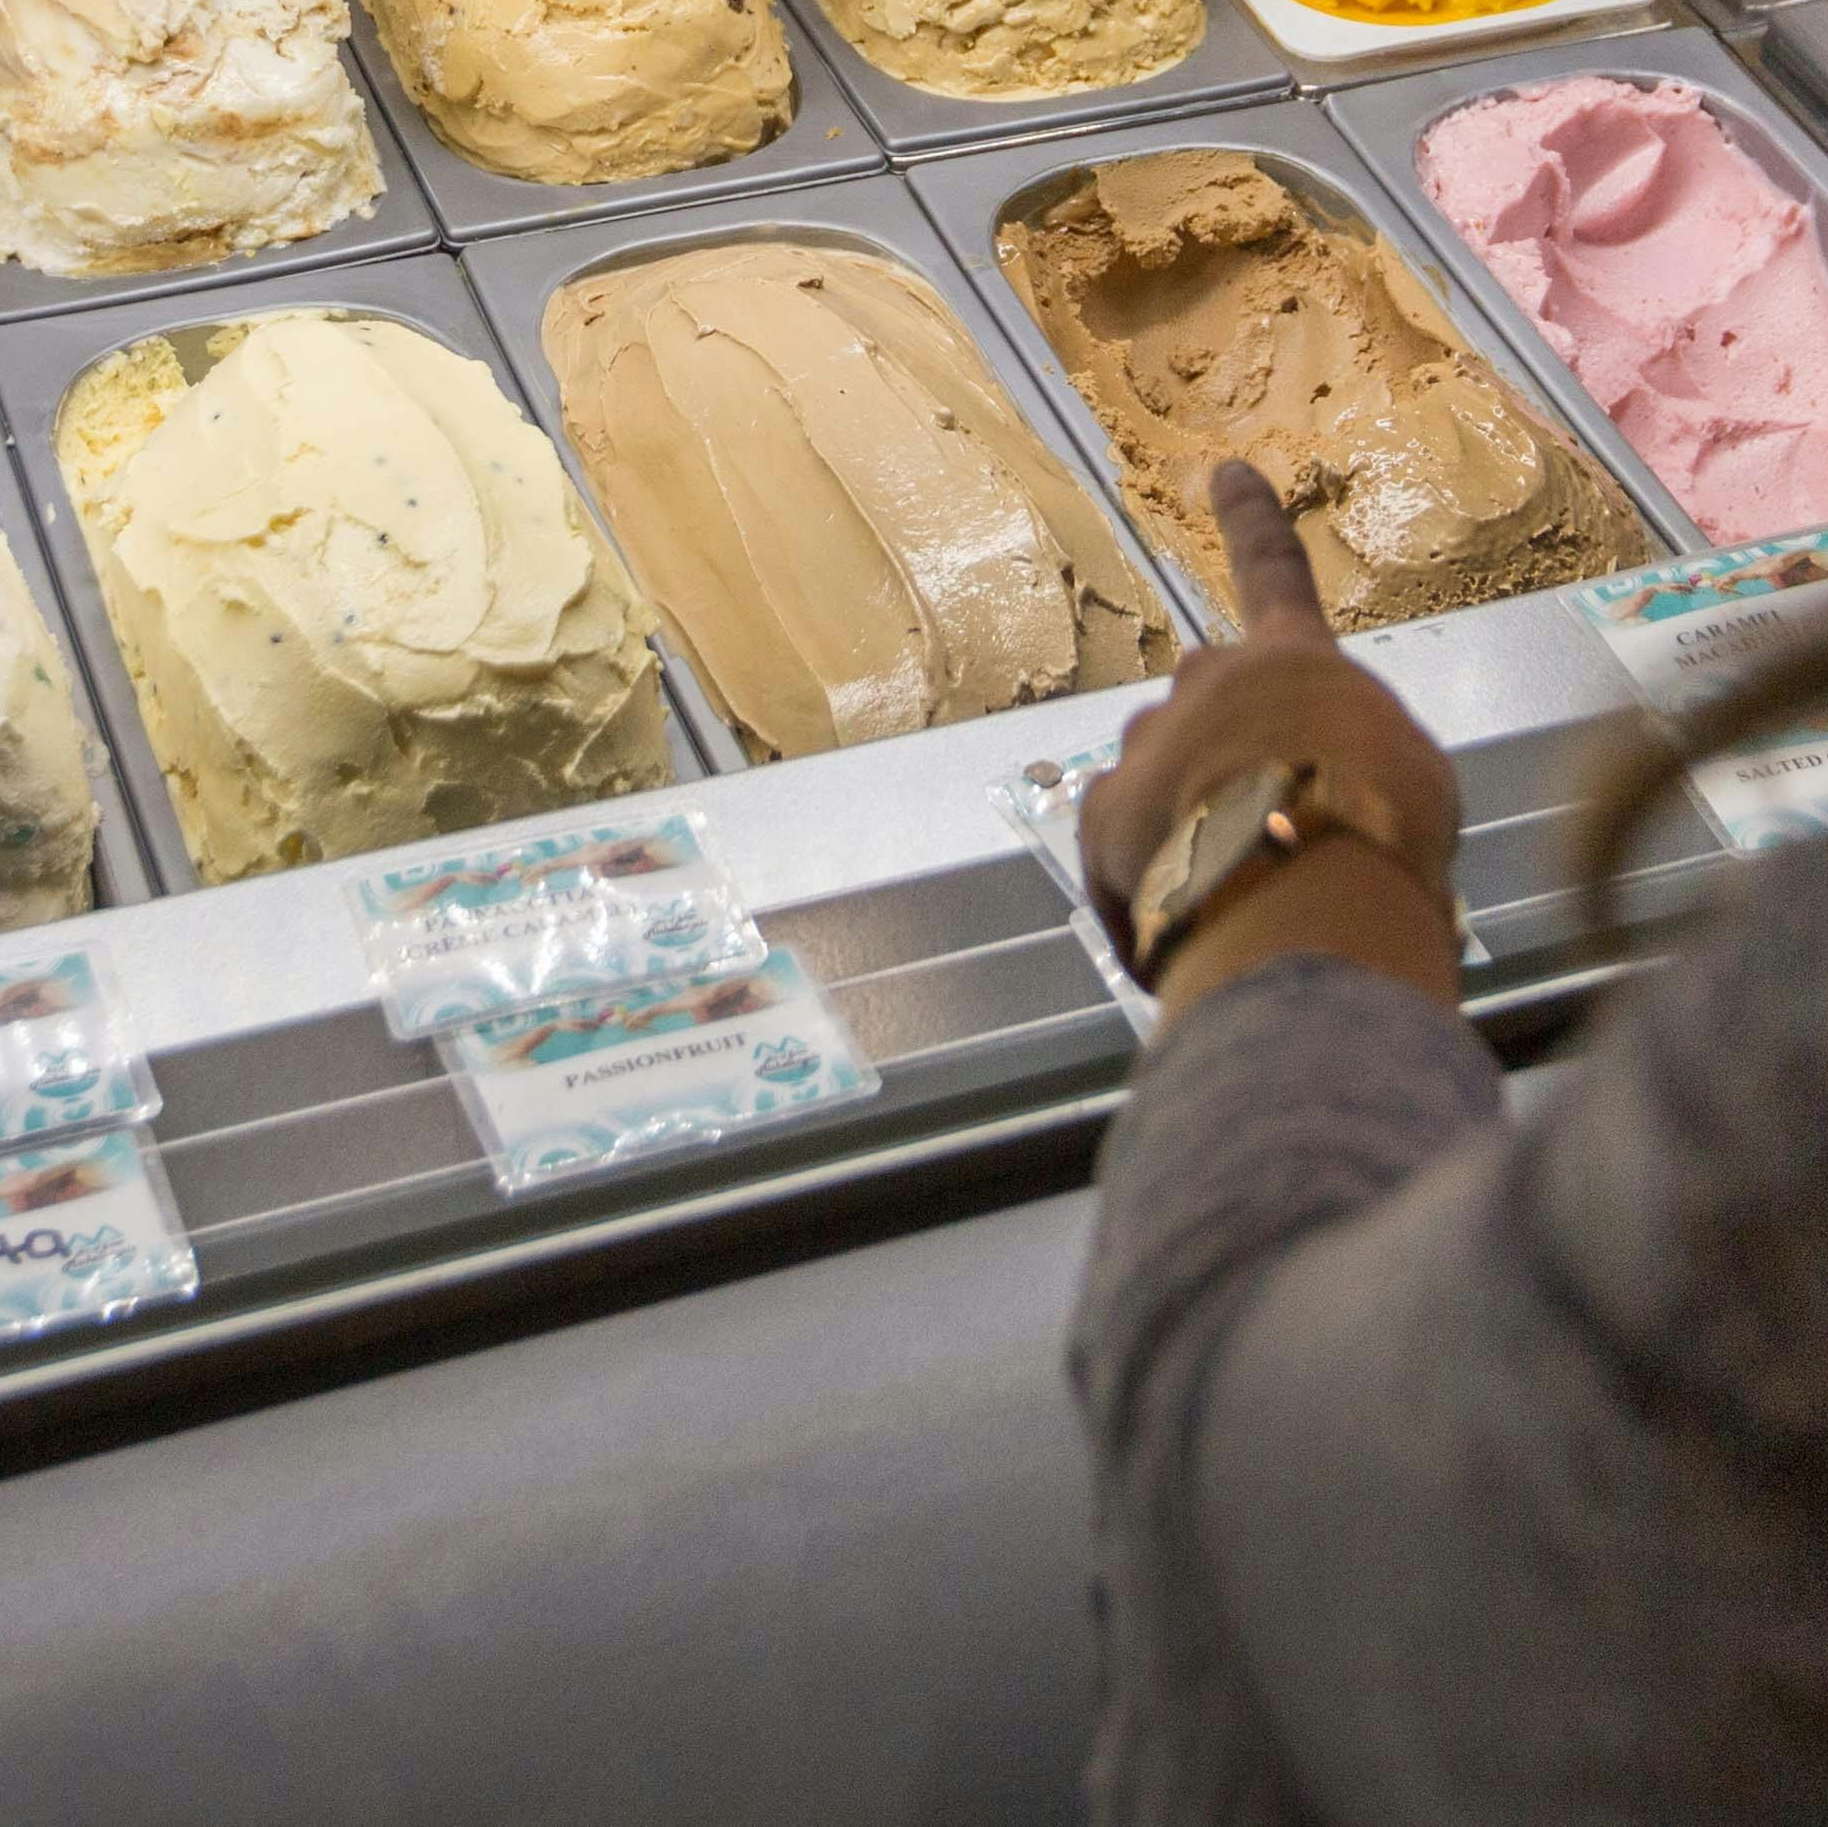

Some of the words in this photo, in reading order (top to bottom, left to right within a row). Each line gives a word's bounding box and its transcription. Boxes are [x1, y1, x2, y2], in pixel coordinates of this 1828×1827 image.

[1676, 610, 1783, 646] CARAMEL
[1736, 753, 1823, 783] SALTED
[564, 1031, 748, 1090] PASSIONFRUIT
